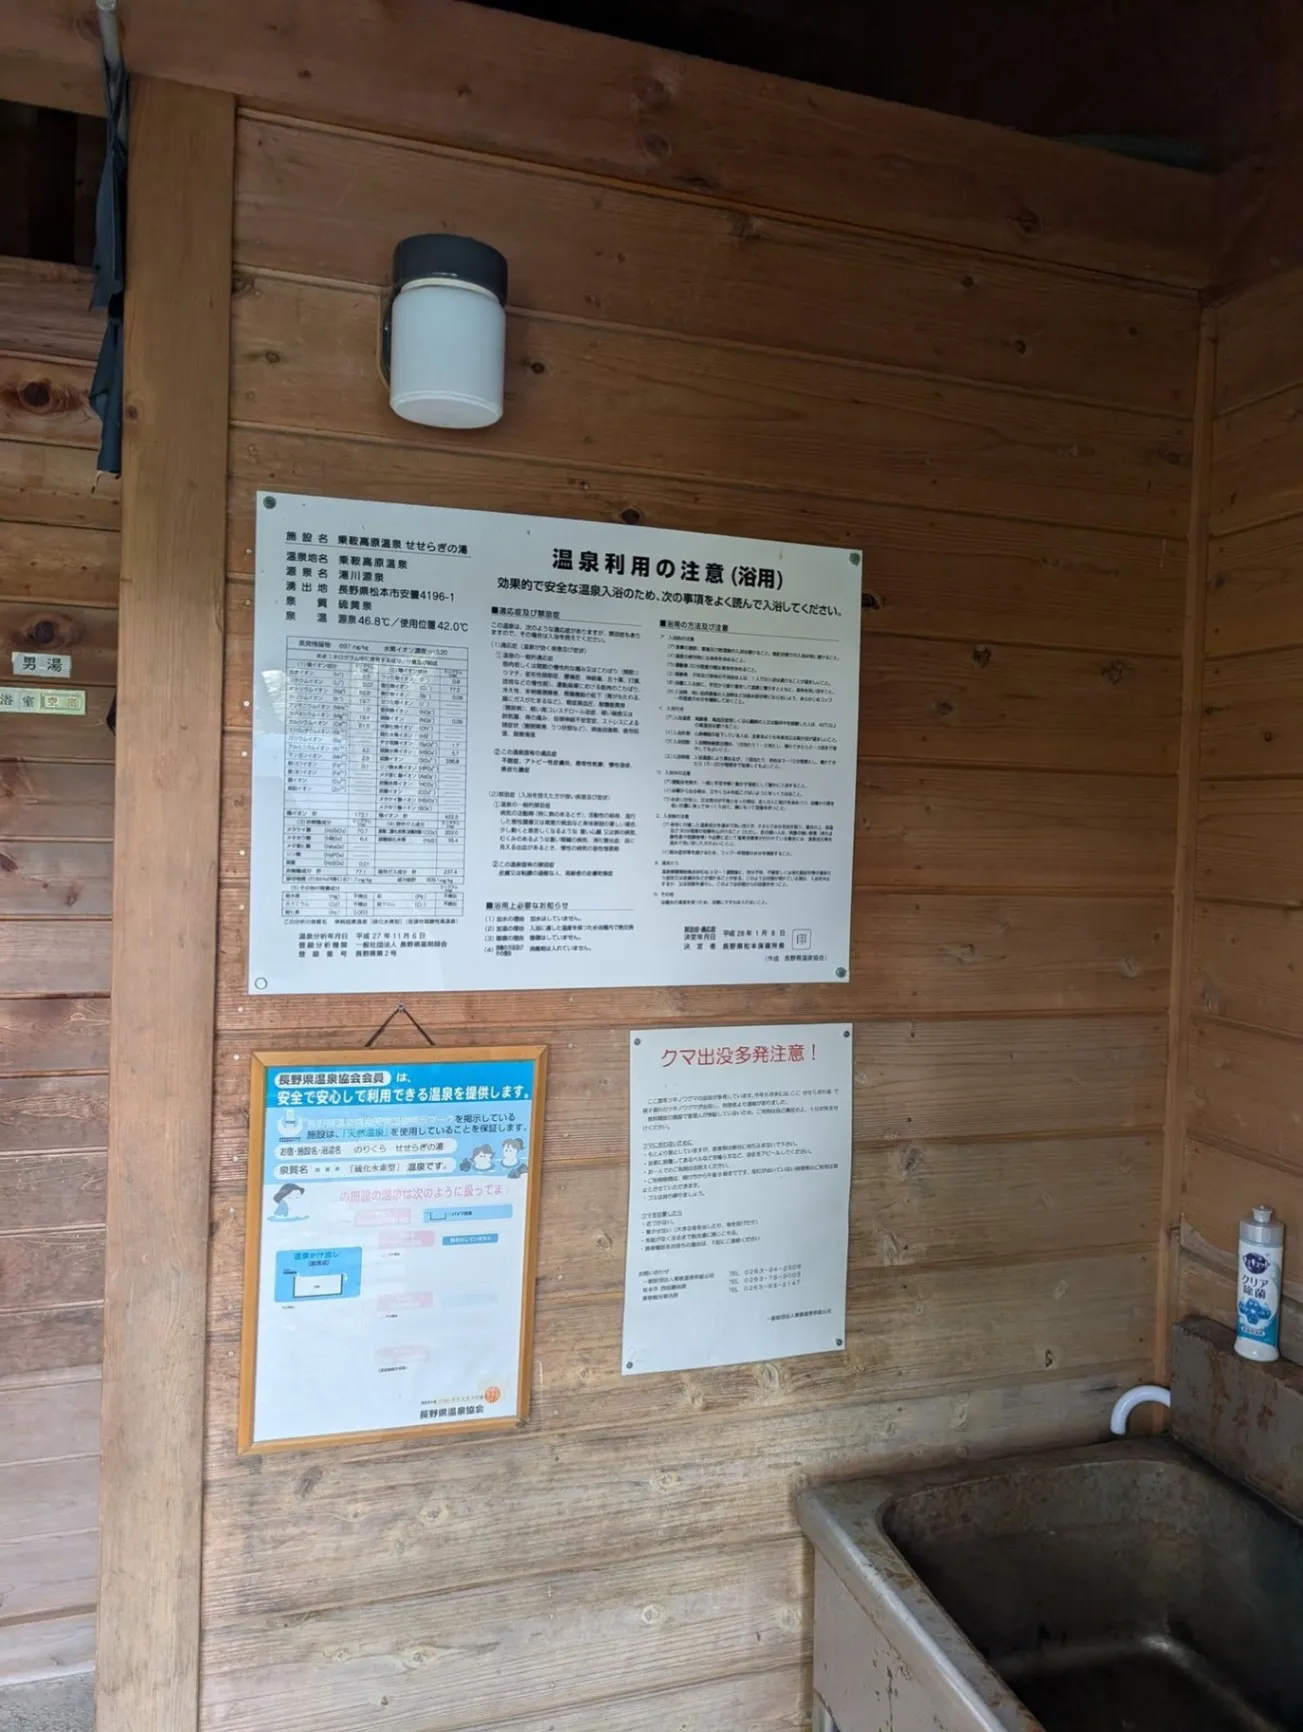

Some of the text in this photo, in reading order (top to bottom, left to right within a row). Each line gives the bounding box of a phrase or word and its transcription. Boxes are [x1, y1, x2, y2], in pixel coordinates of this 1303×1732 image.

[405, 540, 468, 554] せせらぎの湯
[286, 551, 328, 563] 温泉地名
[286, 567, 328, 578] 源泉名
[286, 581, 327, 593] 湧出地
[497, 577, 843, 617] 効果的で安全な温泉入浴のため、次の事項をよく読んで入浴してください。
[23, 656, 62, 673] 男湯
[661, 1044, 816, 1067] クマ出没多発注意！
[278, 1072, 384, 1086] 長野県温泉協会会員
[277, 1085, 529, 1106] 安全で安心して利用できる温泉を提供します。
[279, 1164, 308, 1174] 泉質名
[1242, 1275, 1268, 1288] クリア
[1243, 1285, 1266, 1299] 除菌
